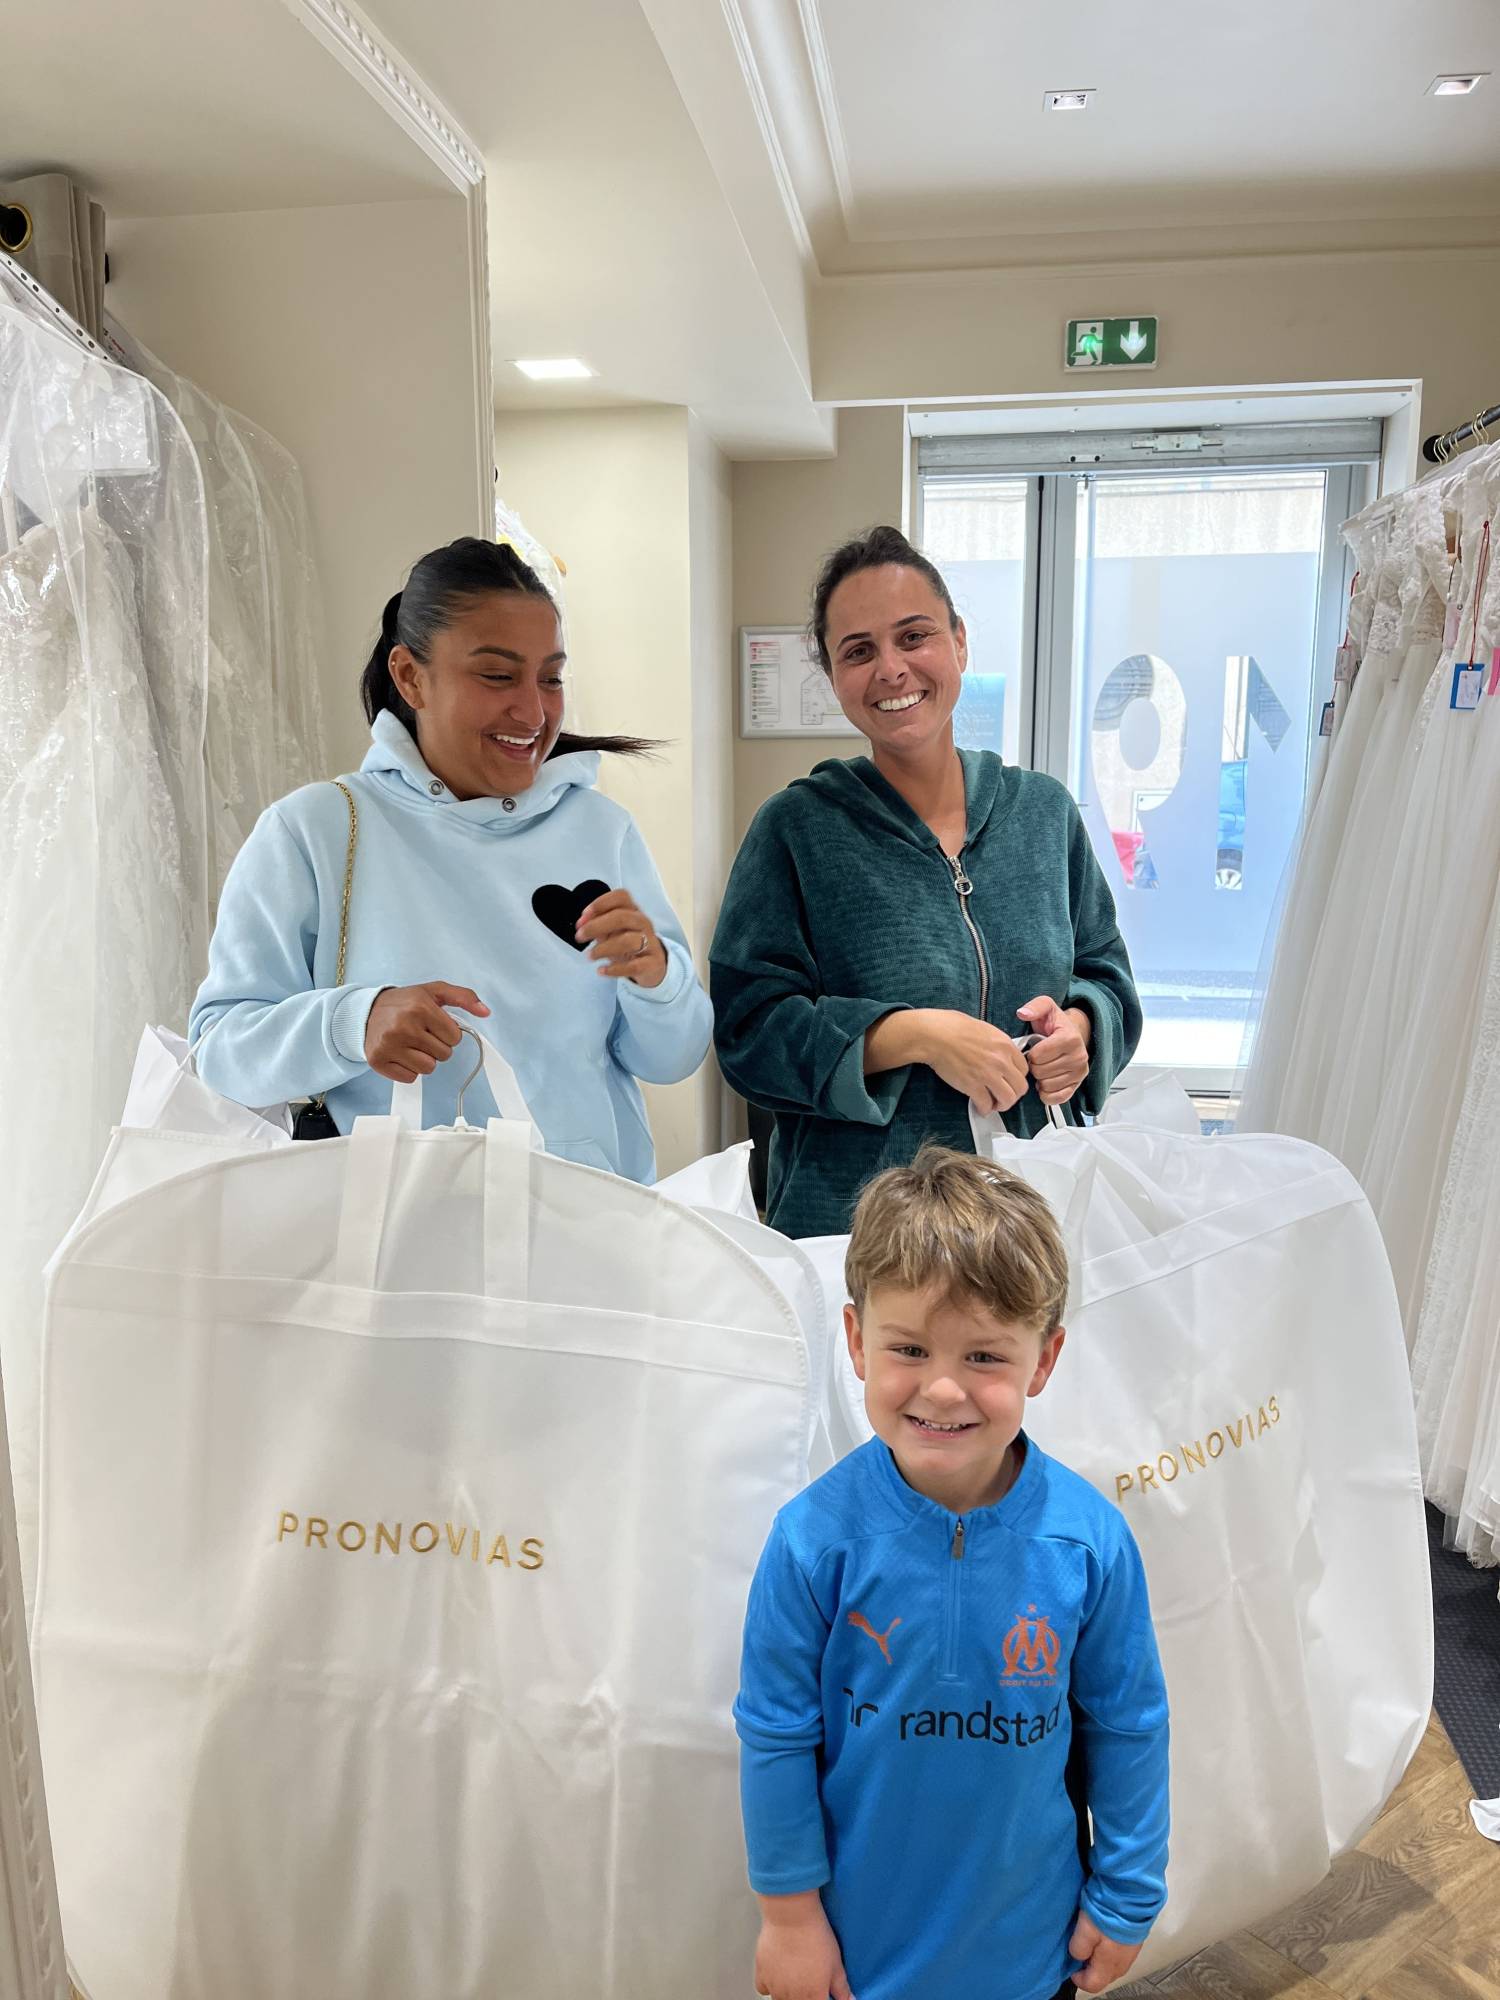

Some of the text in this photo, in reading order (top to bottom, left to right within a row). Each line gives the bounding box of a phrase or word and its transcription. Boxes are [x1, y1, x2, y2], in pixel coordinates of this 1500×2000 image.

[1115, 1395, 1281, 1503] PRONOVIAS
[277, 1510, 545, 1570] PRONOVIAS
[900, 1695, 1062, 1747] randstad
